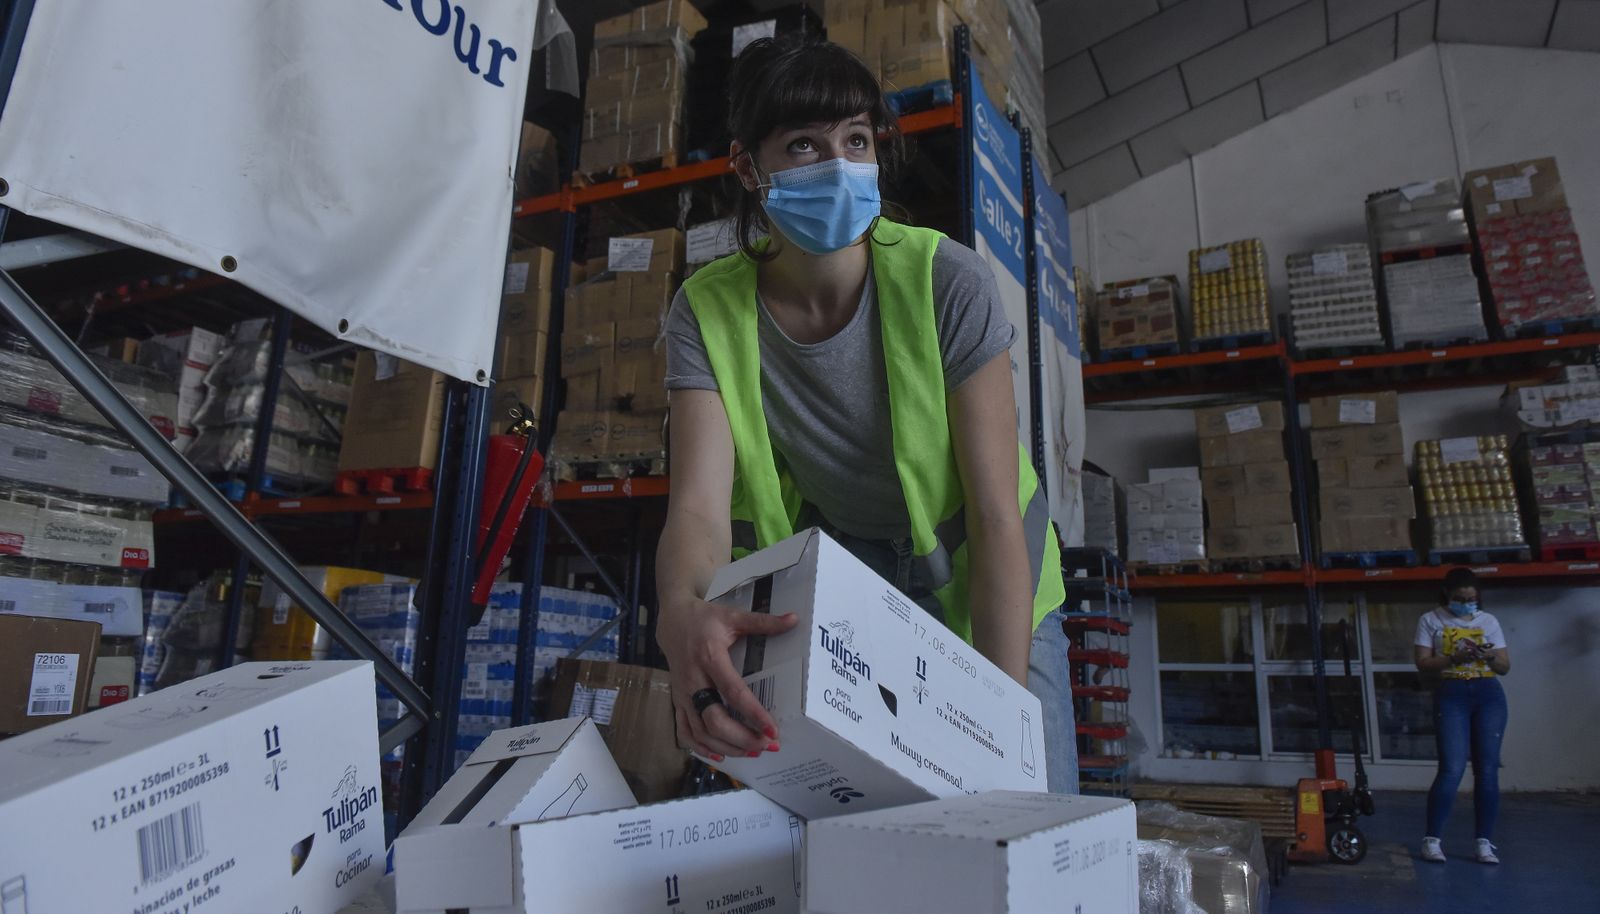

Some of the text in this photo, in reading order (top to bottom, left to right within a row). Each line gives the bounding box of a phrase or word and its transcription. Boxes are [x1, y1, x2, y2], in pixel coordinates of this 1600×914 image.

[382, 0, 517, 88] our
[979, 179, 1012, 246] Calle
[1014, 226, 1022, 259] 2
[37, 655, 66, 665] 72106
[818, 624, 871, 681] Tulipán
[913, 623, 977, 679] 17.06.2020
[832, 658, 857, 686] Rama
[824, 689, 863, 724] Cocinar
[836, 688, 852, 702] para
[936, 707, 943, 718] 12
[949, 716, 961, 730] EAN
[962, 725, 1004, 759] 8719200085398
[946, 702, 953, 713] 12
[959, 711, 977, 728] 250ml
[988, 730, 994, 741] 3L
[507, 736, 540, 748] Tulipán
[112, 786, 126, 802] 12
[131, 785, 137, 795] x
[141, 766, 175, 791] 250ml
[198, 752, 210, 767] 3L
[891, 731, 963, 790] Muuuy cremosa!
[91, 761, 230, 832] 12 x EAN 8719200085398
[808, 777, 848, 791] Upfield
[322, 786, 377, 833] Tulipán
[340, 819, 365, 844] Rama
[660, 817, 739, 849] 17.06.2020
[186, 877, 200, 891] de
[203, 857, 236, 885] grasas
[335, 854, 373, 888] Cocinar
[347, 848, 361, 867] para
[193, 884, 220, 907] leche
[706, 899, 714, 911] 12
[722, 889, 742, 906] 250ml
[755, 884, 764, 896] 3L
